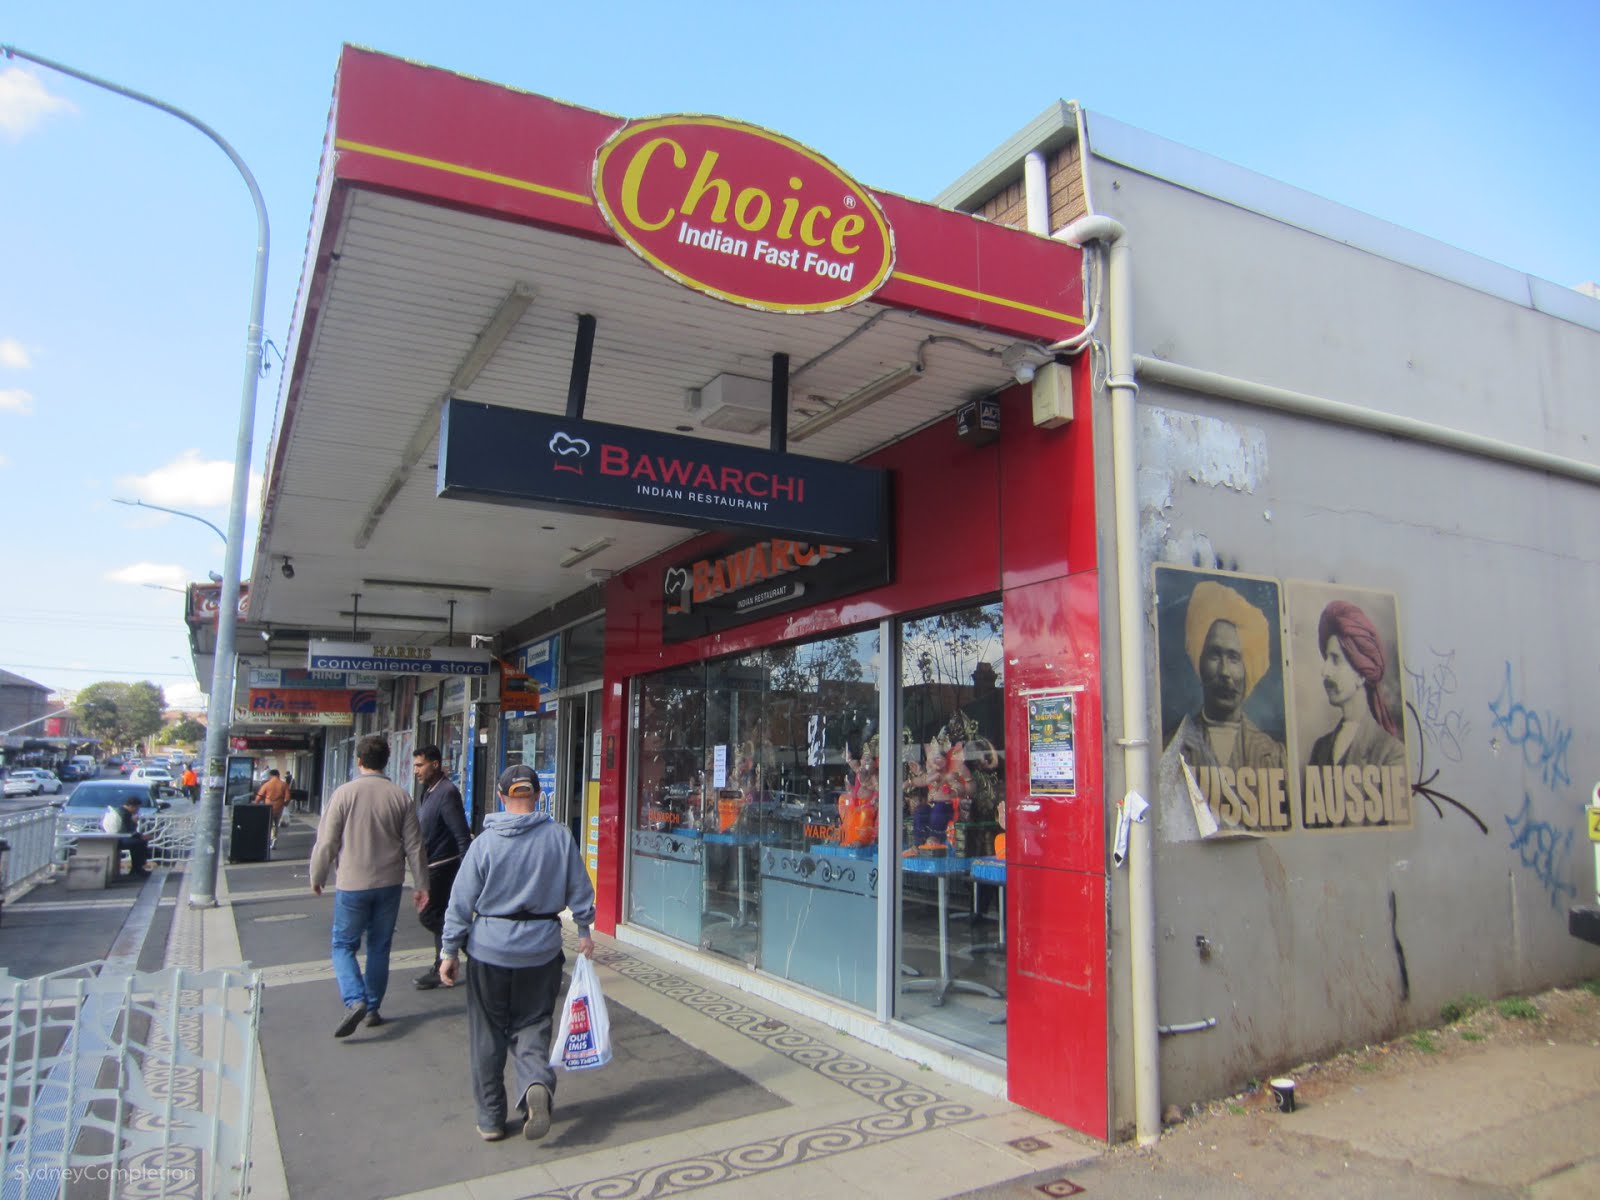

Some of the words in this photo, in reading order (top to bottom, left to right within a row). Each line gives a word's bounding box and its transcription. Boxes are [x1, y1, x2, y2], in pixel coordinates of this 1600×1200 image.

[621, 137, 865, 255] Choice
[677, 221, 748, 257] Indian
[754, 240, 798, 270] Fast
[803, 252, 854, 282] Food
[599, 443, 805, 503] BAWARCHI
[637, 484, 683, 501] INDIAN
[688, 492, 769, 511] RESTAURANT
[692, 538, 850, 603] BAWARC
[754, 585, 787, 604] RESTAURANT
[317, 658, 432, 672] convenience
[440, 662, 483, 674] store
[373, 645, 432, 659] HARRIS
[253, 691, 285, 709] Ria
[1191, 765, 1289, 828] USSIE
[1305, 764, 1409, 824] AUSSIE
